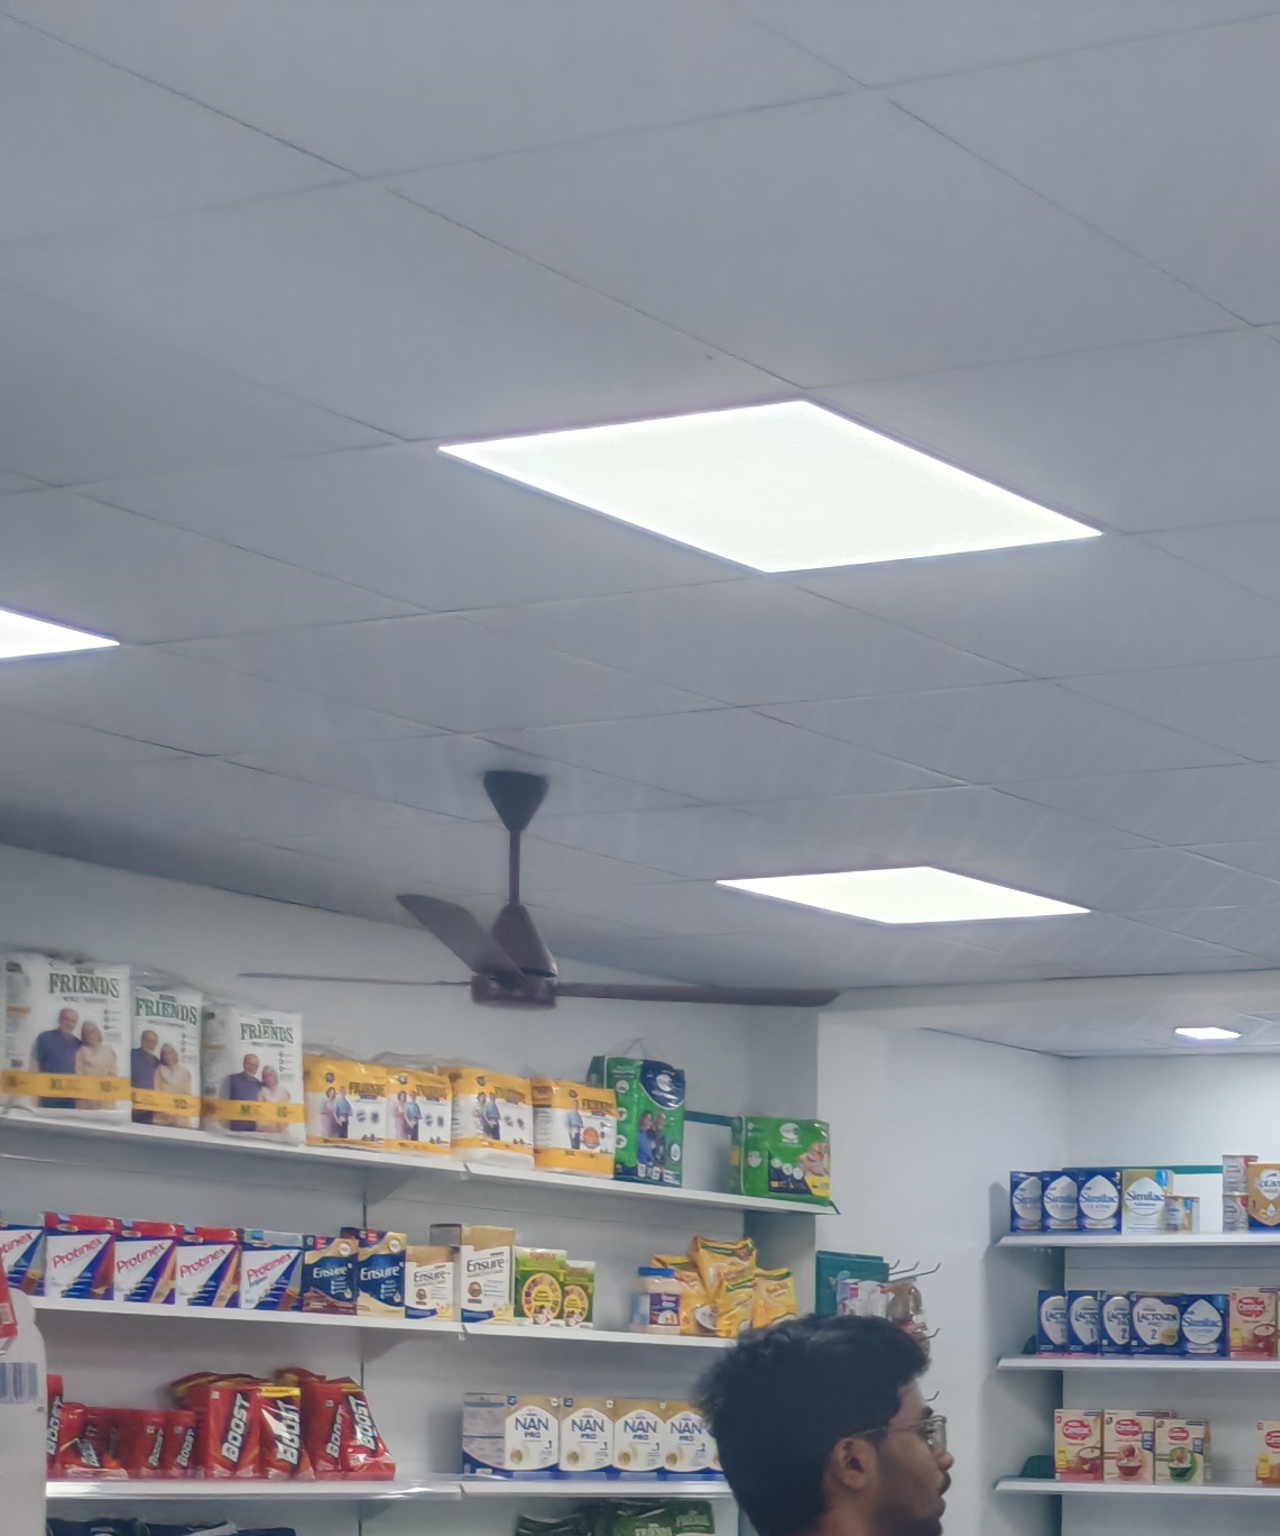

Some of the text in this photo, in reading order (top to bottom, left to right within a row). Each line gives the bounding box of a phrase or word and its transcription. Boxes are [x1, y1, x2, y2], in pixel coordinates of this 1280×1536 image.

[49, 973, 120, 998] FRIENDS
[135, 997, 198, 1025] FRIENDS
[240, 1023, 294, 1044] FRIENDS
[53, 1236, 103, 1269] Protinex
[116, 1242, 166, 1273] Protinex
[180, 1248, 227, 1278] Protinex
[246, 1251, 293, 1281] Protinex
[313, 1266, 348, 1278] Ensure
[467, 1257, 506, 1274] Ensure
[360, 1267, 400, 1281] Ensure
[413, 1270, 447, 1283] Ensure
[221, 1392, 251, 1463] BOOST
[515, 1417, 548, 1433] NAN
[571, 1418, 604, 1433] NAN
[623, 1419, 657, 1434] NAN
[670, 1421, 703, 1435] NAN
